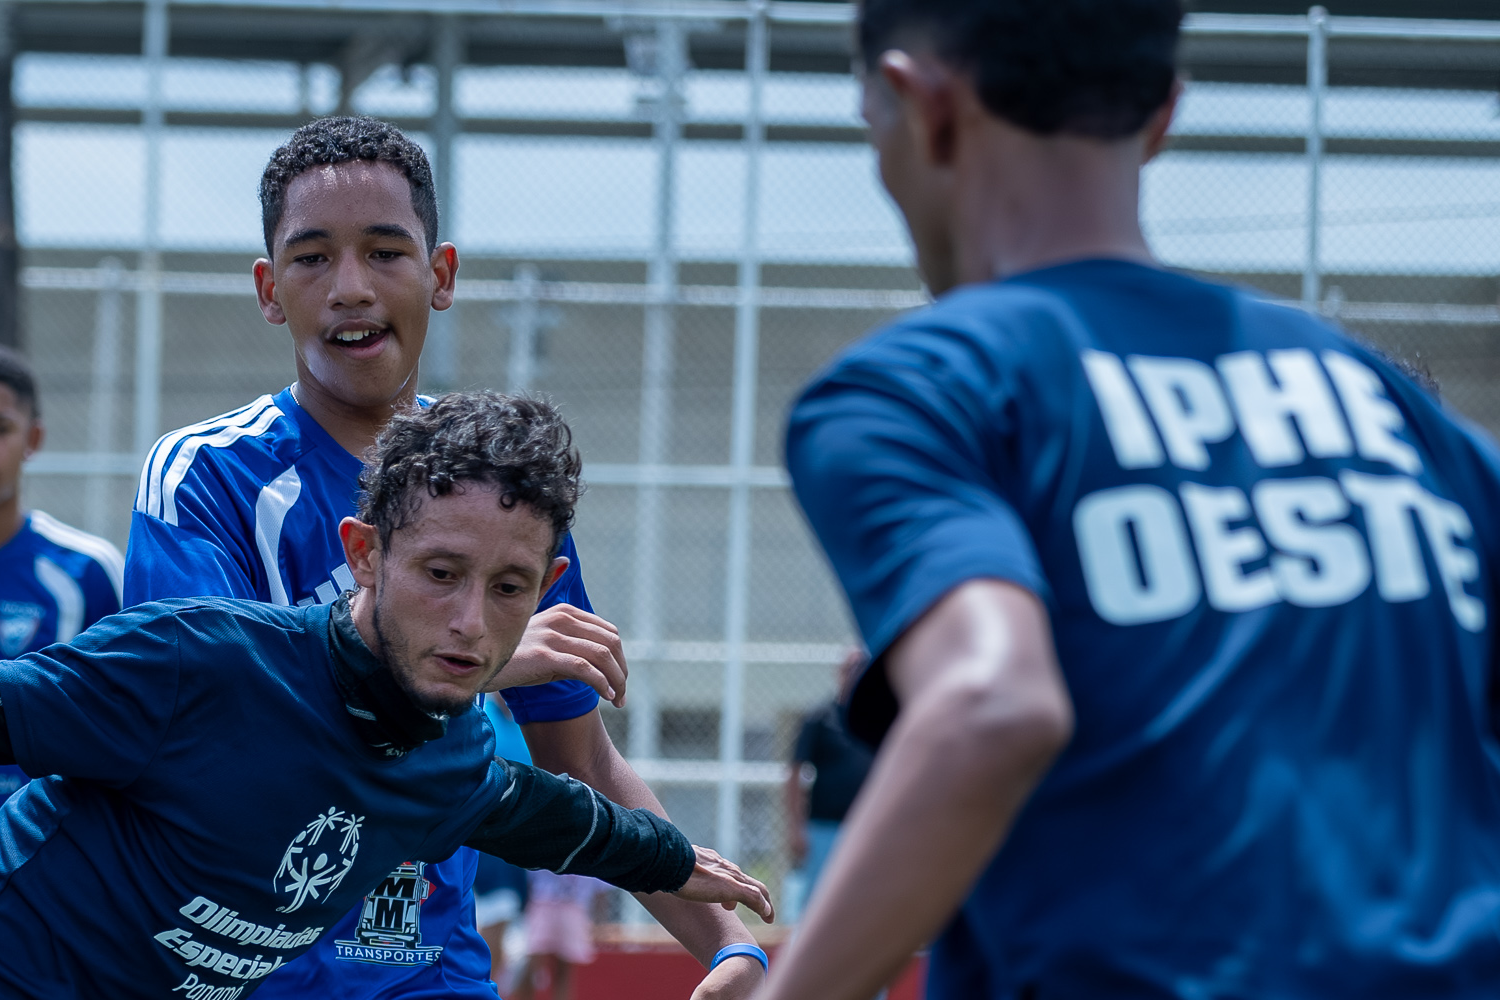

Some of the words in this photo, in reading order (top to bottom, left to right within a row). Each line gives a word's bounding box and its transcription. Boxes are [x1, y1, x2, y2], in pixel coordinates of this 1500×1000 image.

[1080, 349, 1421, 473] IPHE
[1073, 471, 1484, 632] OESTE
[178, 895, 325, 949] Olimpiadas
[153, 927, 289, 980] Especial
[335, 944, 441, 962] TRANSPORTES
